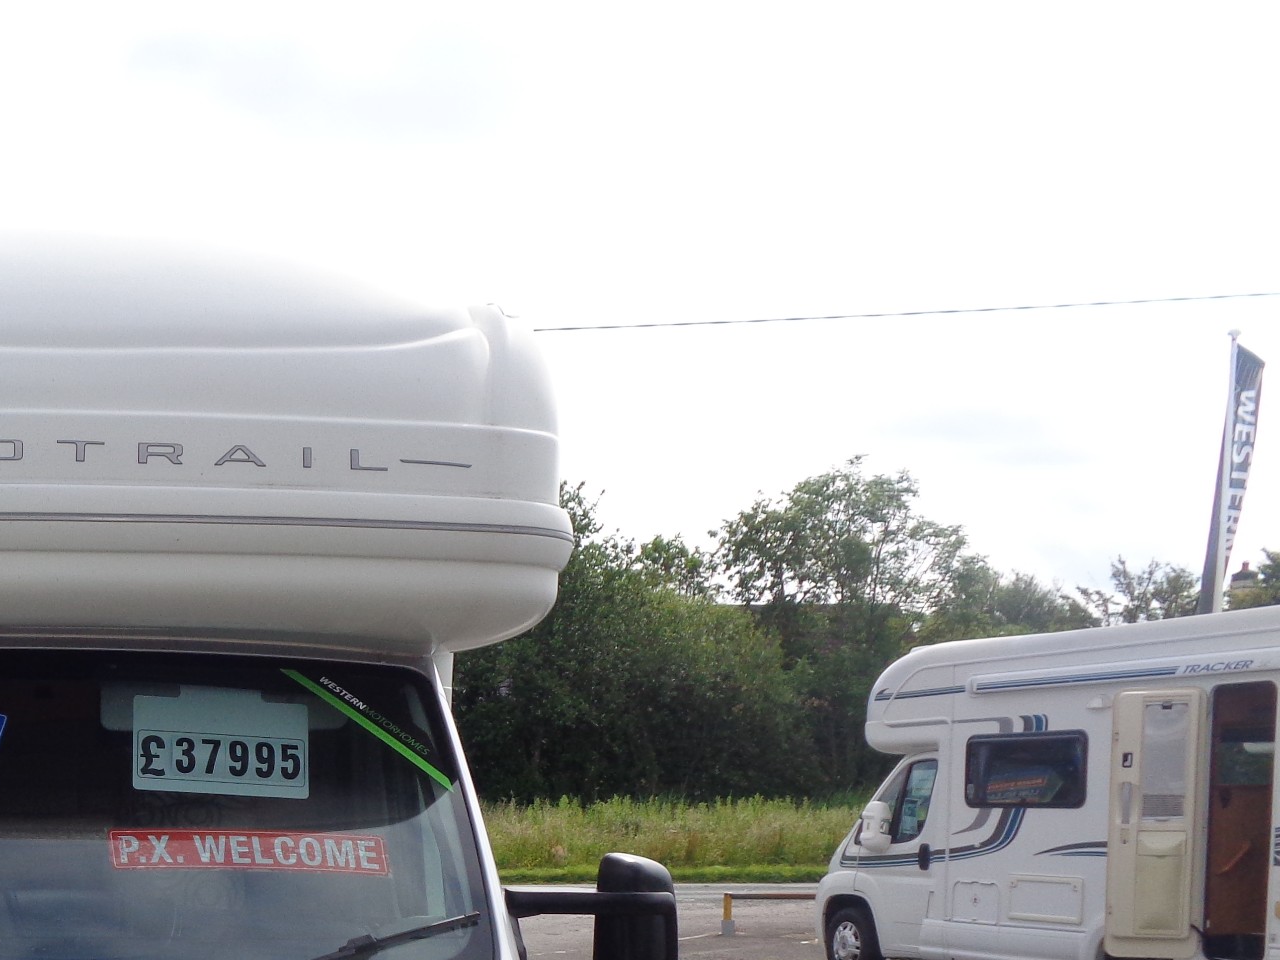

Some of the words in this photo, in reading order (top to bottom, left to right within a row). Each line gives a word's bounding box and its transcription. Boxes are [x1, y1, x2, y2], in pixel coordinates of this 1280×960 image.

[1182, 660, 1254, 674] TRACKER
[140, 734, 302, 781] £37995
[118, 834, 183, 864] P.X.
[195, 834, 380, 870] WELCOME
